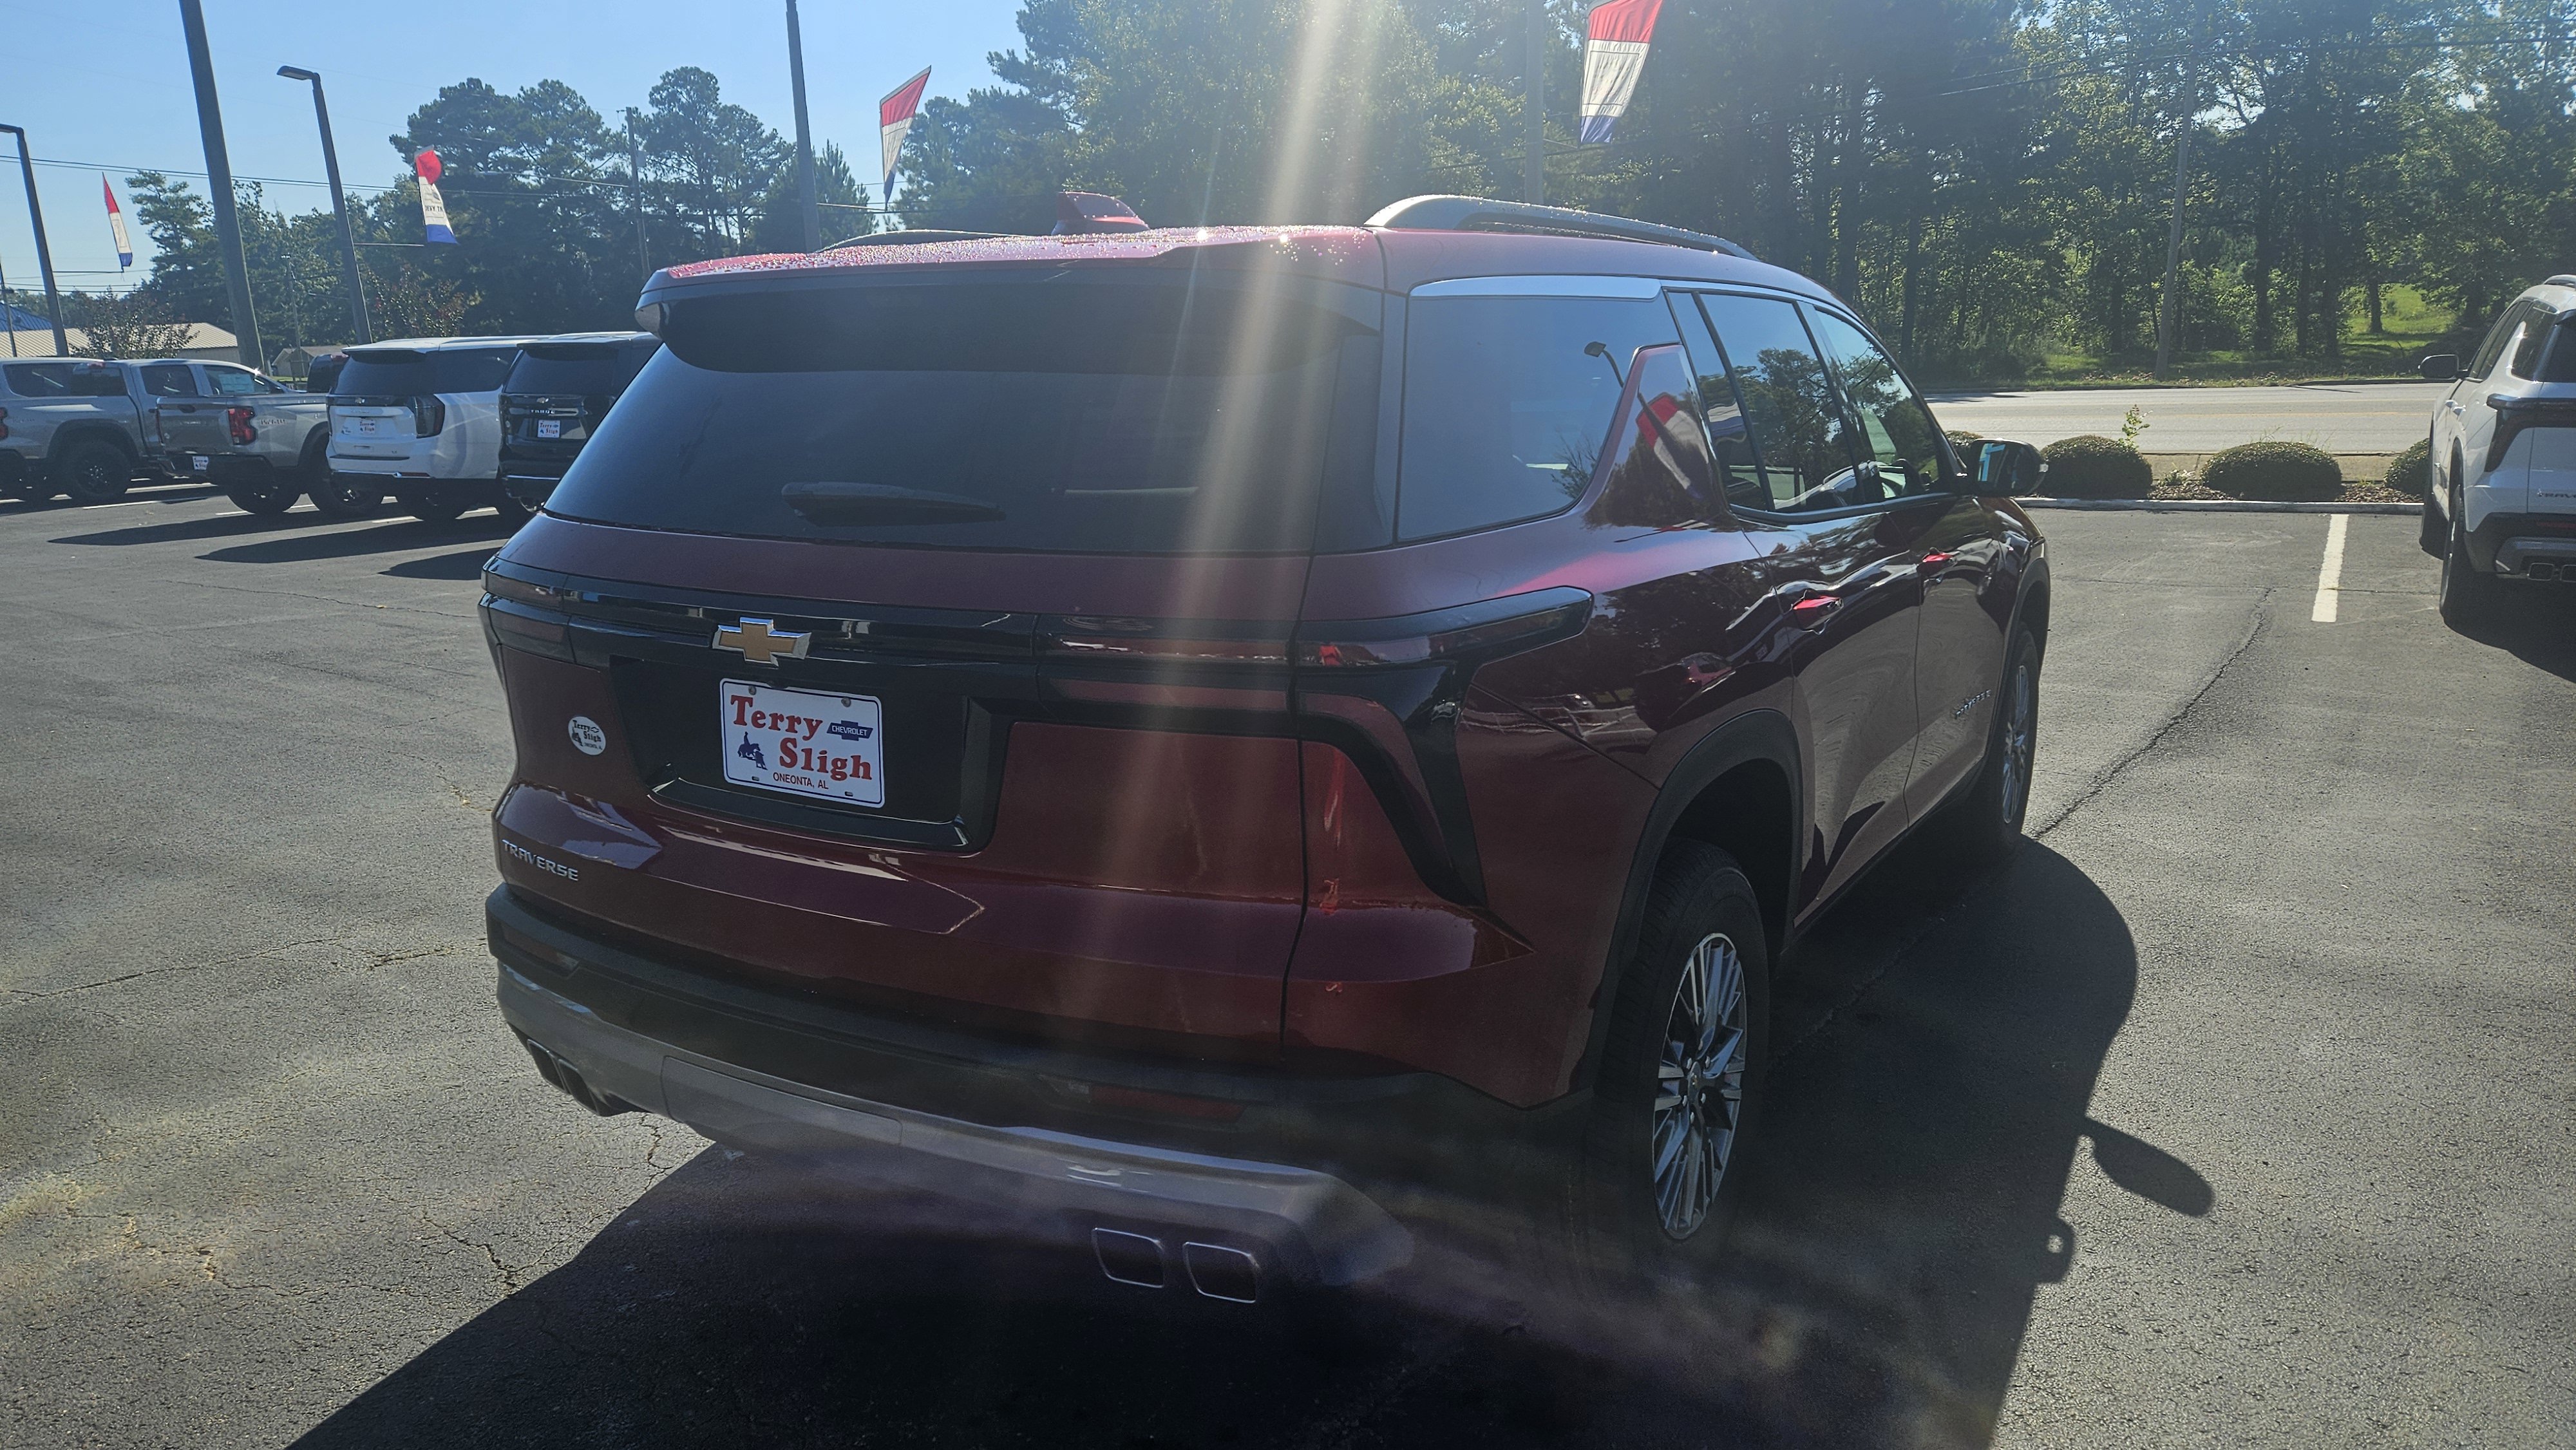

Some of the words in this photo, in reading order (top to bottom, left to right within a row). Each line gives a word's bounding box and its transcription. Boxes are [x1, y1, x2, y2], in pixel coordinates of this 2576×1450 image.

[573, 719, 591, 731] Terry
[730, 695, 823, 741] Terry
[583, 731, 601, 742] Sligh
[831, 725, 867, 736] CHEVROLET
[779, 737, 872, 781] Sligh
[773, 772, 815, 789] ONEONTA,
[818, 780, 829, 789] AL
[502, 839, 579, 881] TRAVERSE
